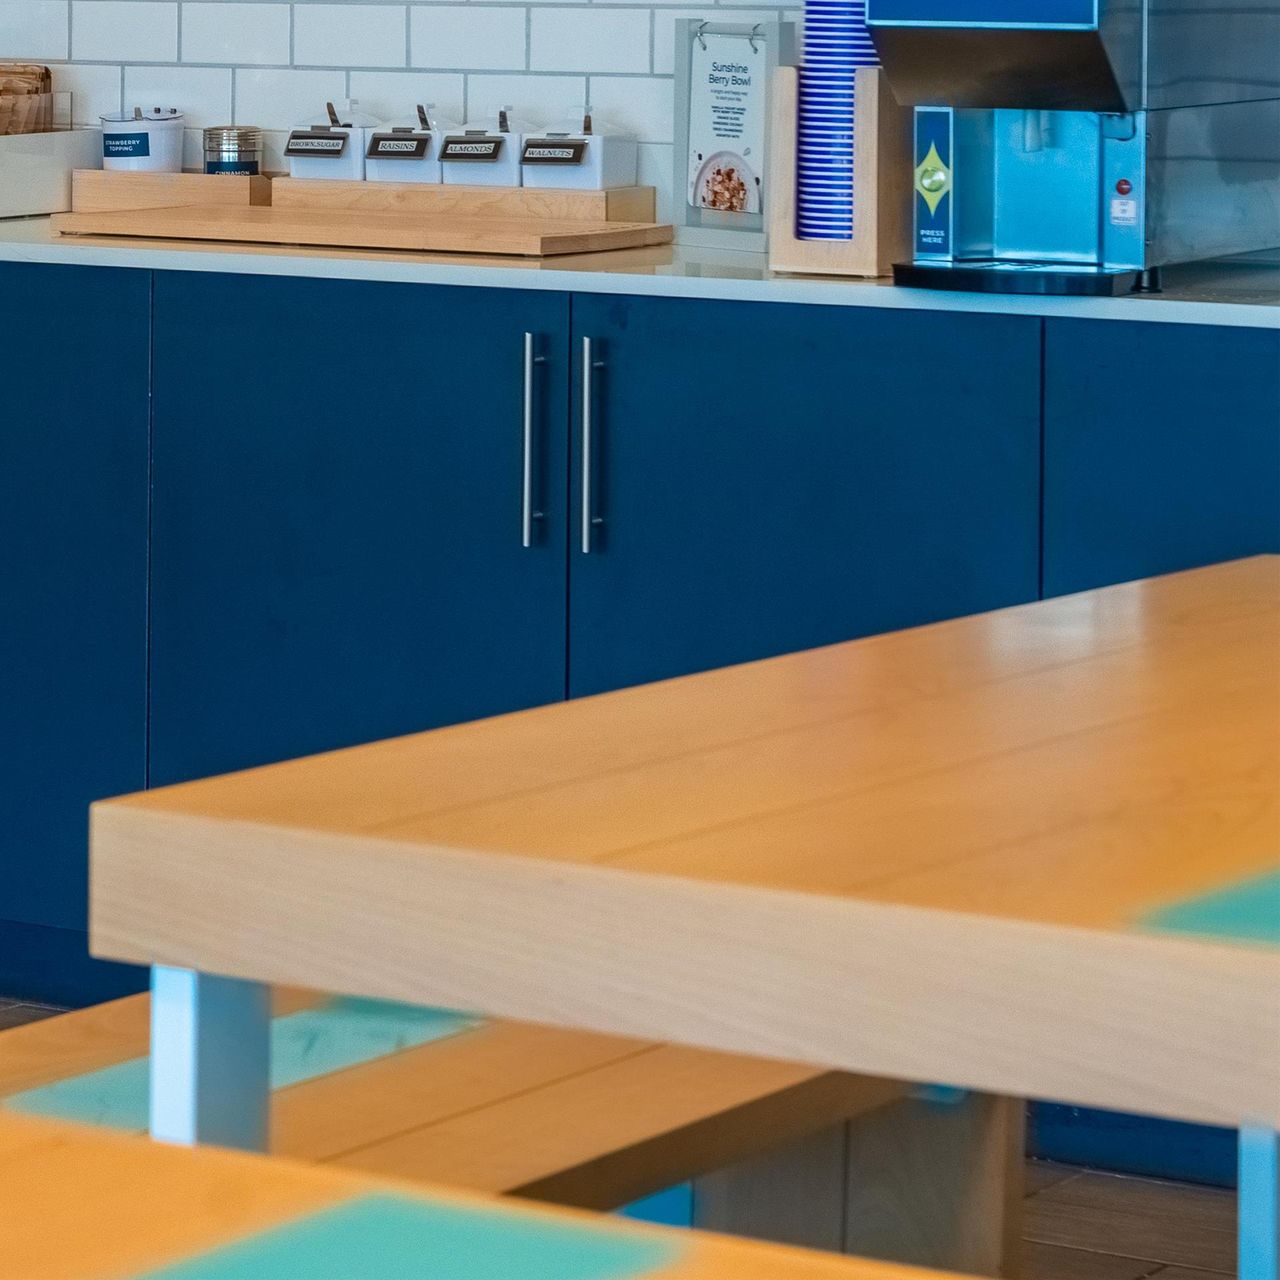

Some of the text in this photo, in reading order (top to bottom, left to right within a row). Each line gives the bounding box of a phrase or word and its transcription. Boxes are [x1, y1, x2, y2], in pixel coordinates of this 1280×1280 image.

[712, 62, 748, 73] Sunshine
[709, 74, 751, 87] Berry Bowl
[380, 141, 415, 150] RAISINS
[448, 144, 493, 152] ALMONDS
[528, 149, 572, 157] WALNUTS
